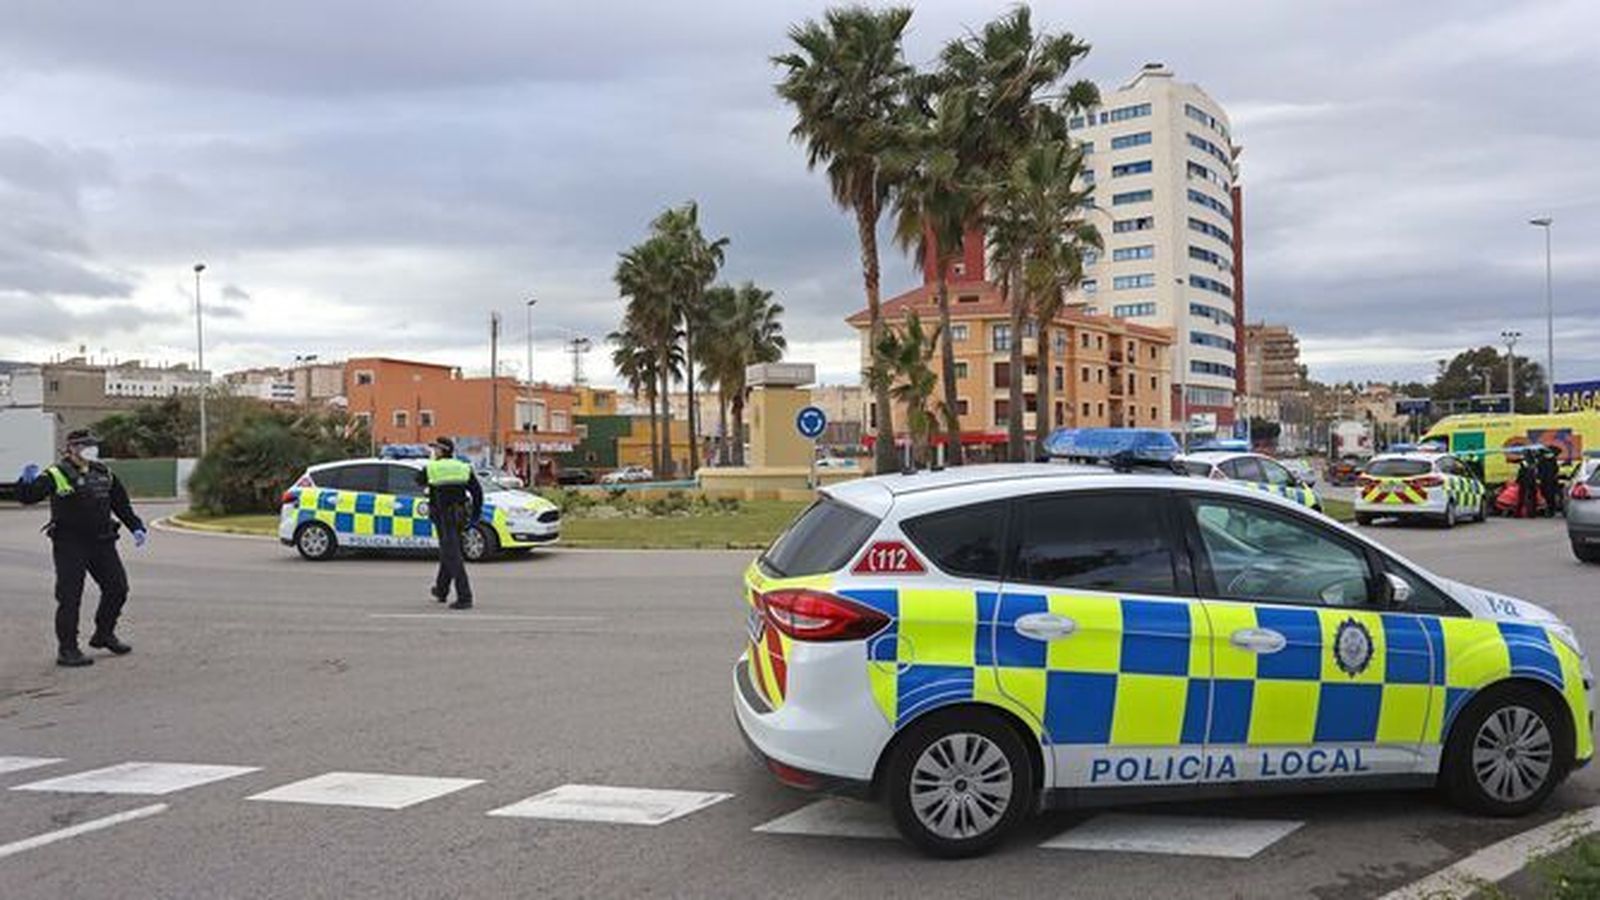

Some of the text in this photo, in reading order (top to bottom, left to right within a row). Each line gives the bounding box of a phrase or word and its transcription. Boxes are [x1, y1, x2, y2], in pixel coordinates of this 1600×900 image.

[348, 536, 433, 547] POLICIA LOCAL
[877, 548, 908, 570] 112
[1090, 747, 1372, 784] POLICIA LOCAL
